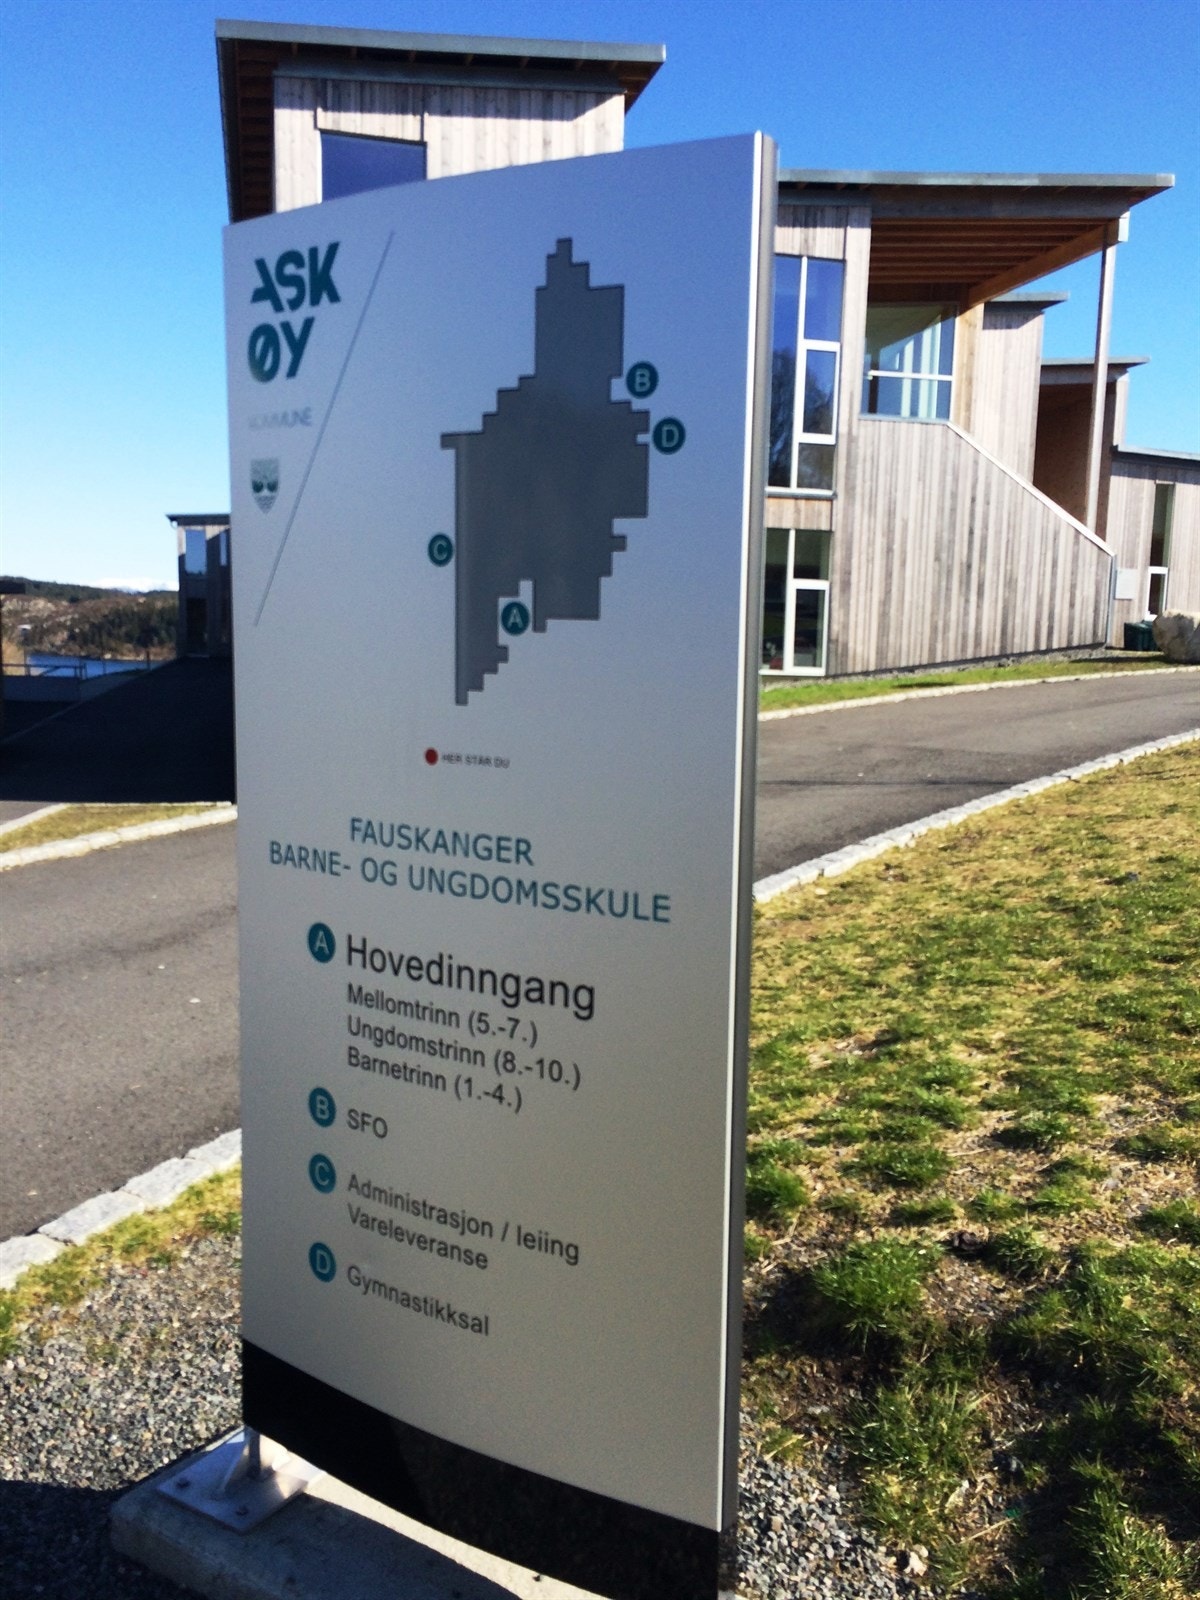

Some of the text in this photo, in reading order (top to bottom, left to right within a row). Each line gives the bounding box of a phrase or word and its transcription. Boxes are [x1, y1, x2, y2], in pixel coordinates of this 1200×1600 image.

[251, 241, 341, 313] ASK
[633, 368, 651, 391] B
[662, 426, 678, 447] D
[433, 540, 448, 561] C
[507, 607, 524, 627] A
[442, 752, 462, 765] HER
[493, 756, 510, 769] DU
[350, 817, 534, 866] FAUSKANGER
[269, 840, 671, 924] BARNE- OG UNGDOMSSKULE
[314, 930, 596, 1020] A Hovedinngang
[347, 983, 538, 1048] Mellomtrinn (5.-7.)
[347, 1015, 582, 1091] Ungdomstrinn (8.-10.)
[347, 1046, 523, 1115] Barnetrinn (1.-4.)
[316, 1096, 389, 1140] B SFO
[315, 1163, 580, 1266] C Administrasjon / leiing
[348, 1203, 489, 1270] Vareleveranse
[316, 1252, 490, 1336] D Gymnastikksal
